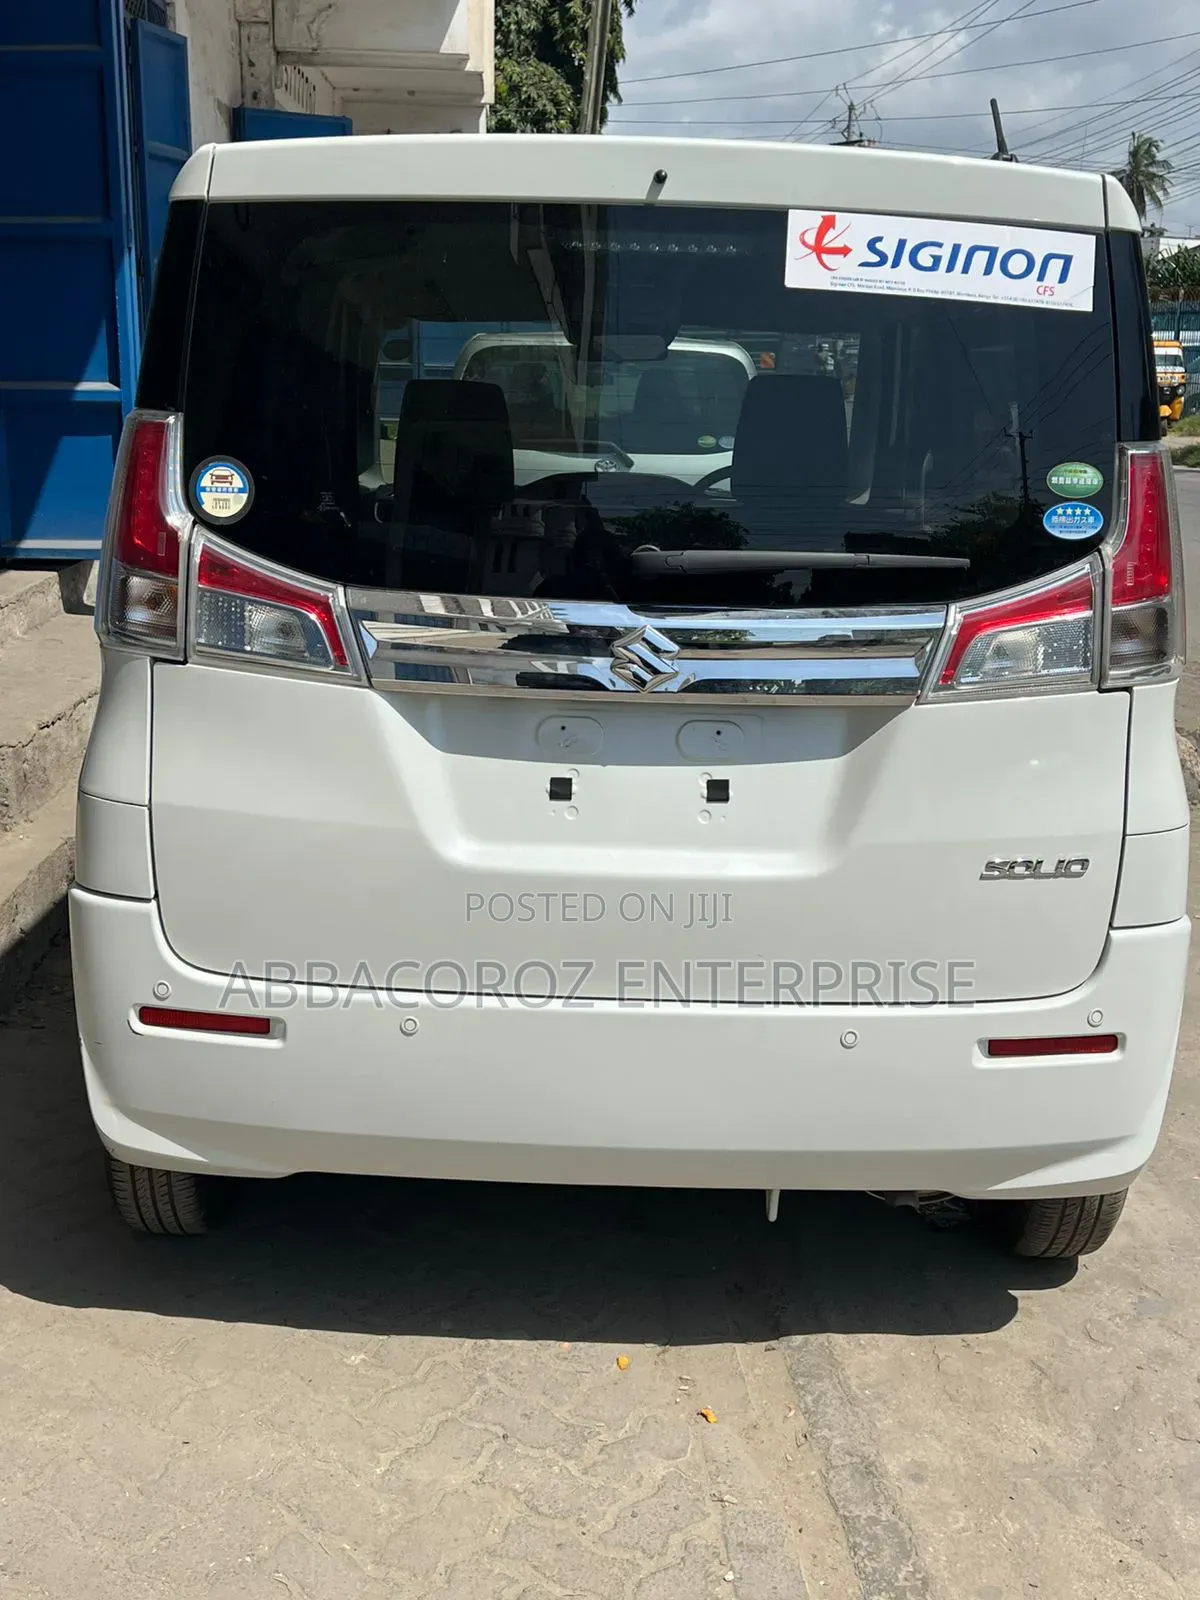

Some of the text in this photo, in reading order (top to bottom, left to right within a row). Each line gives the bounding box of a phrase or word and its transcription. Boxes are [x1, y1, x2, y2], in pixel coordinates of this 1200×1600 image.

[858, 236, 1073, 284] SIGINON
[1036, 285, 1055, 297] CFS
[979, 858, 1090, 880] SOLIO
